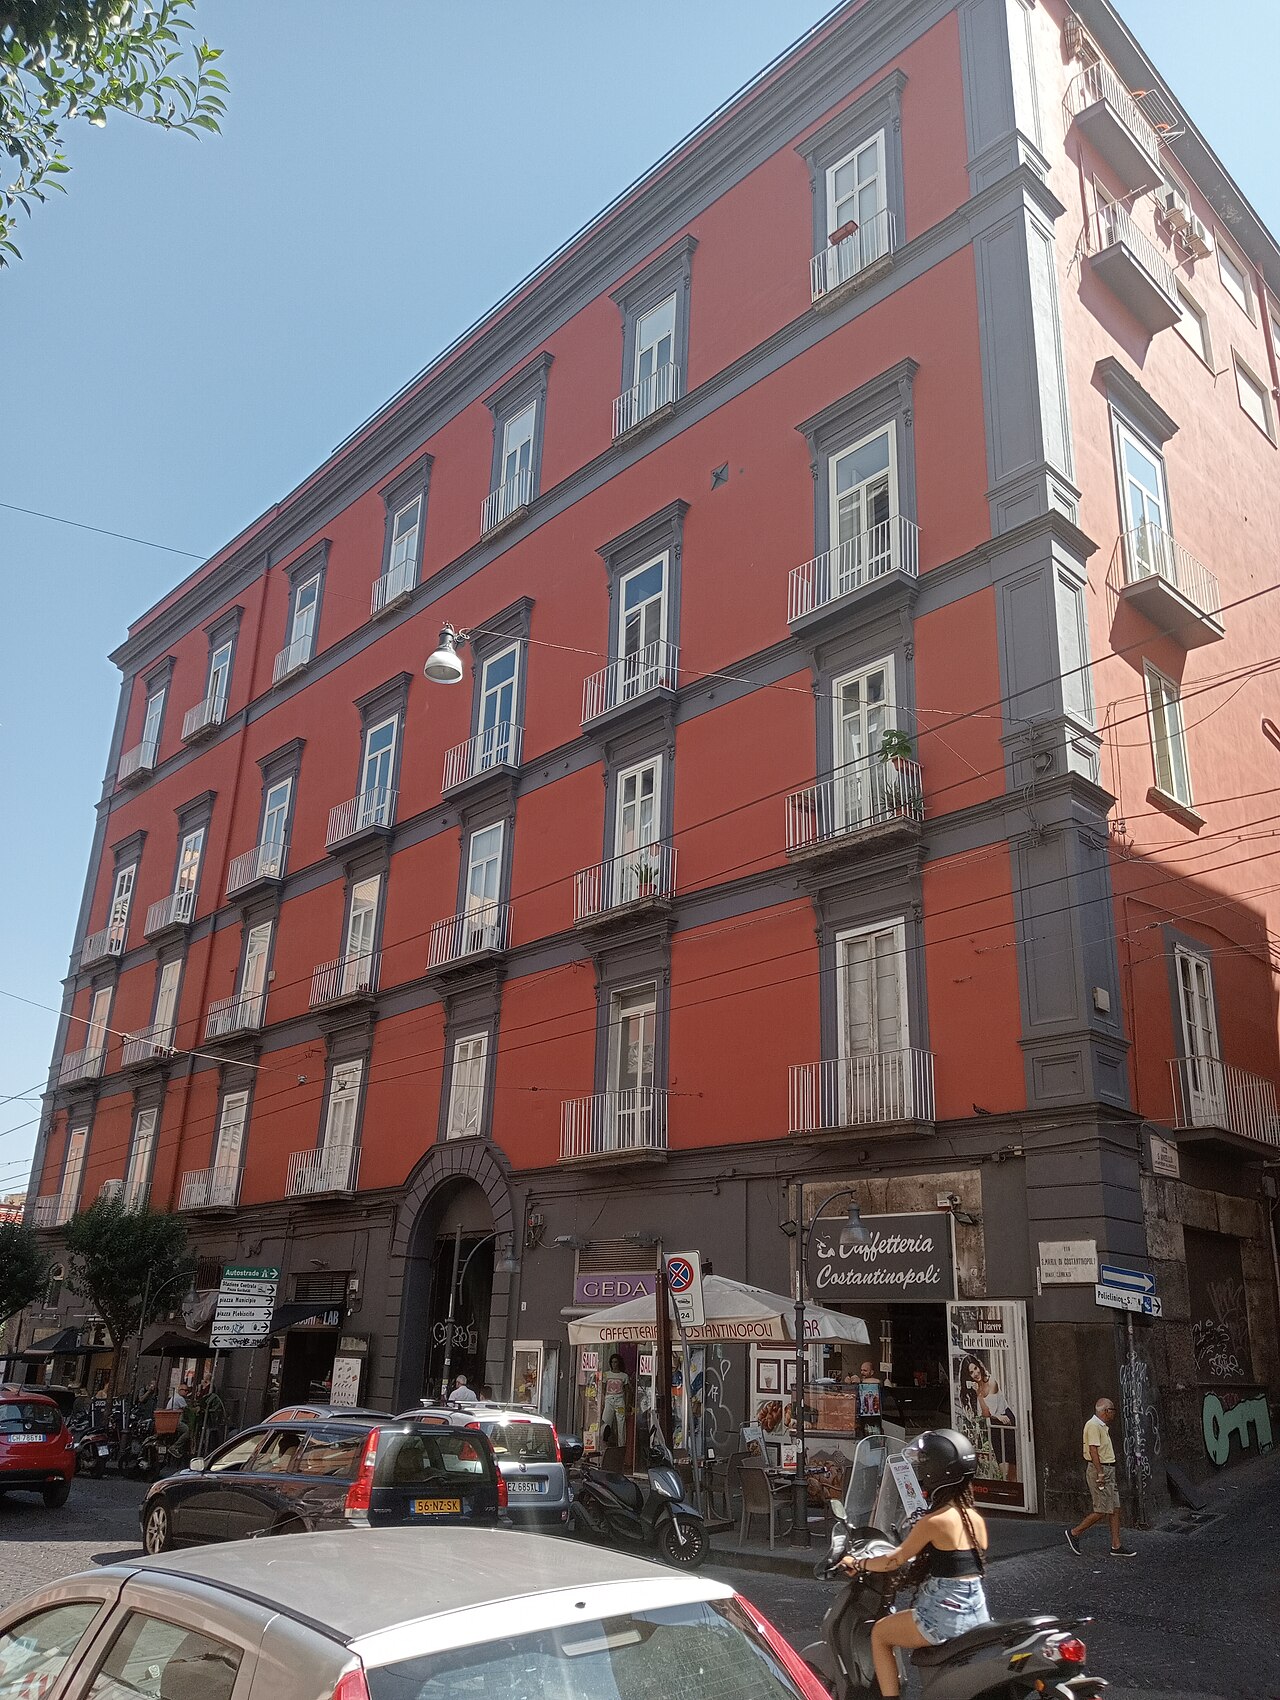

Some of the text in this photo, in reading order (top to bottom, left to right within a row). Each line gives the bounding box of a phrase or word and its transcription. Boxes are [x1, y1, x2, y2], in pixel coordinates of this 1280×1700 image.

[225, 1269, 260, 1277] Autostrade
[816, 1263, 940, 1290] Costantinopoli
[583, 1281, 648, 1298] GEDA
[1097, 1290, 1123, 1304] Policlinico
[323, 1310, 339, 1326] LAB
[796, 1319, 821, 1337] AR
[984, 1321, 1002, 1333] piacere
[963, 1335, 976, 1347] che
